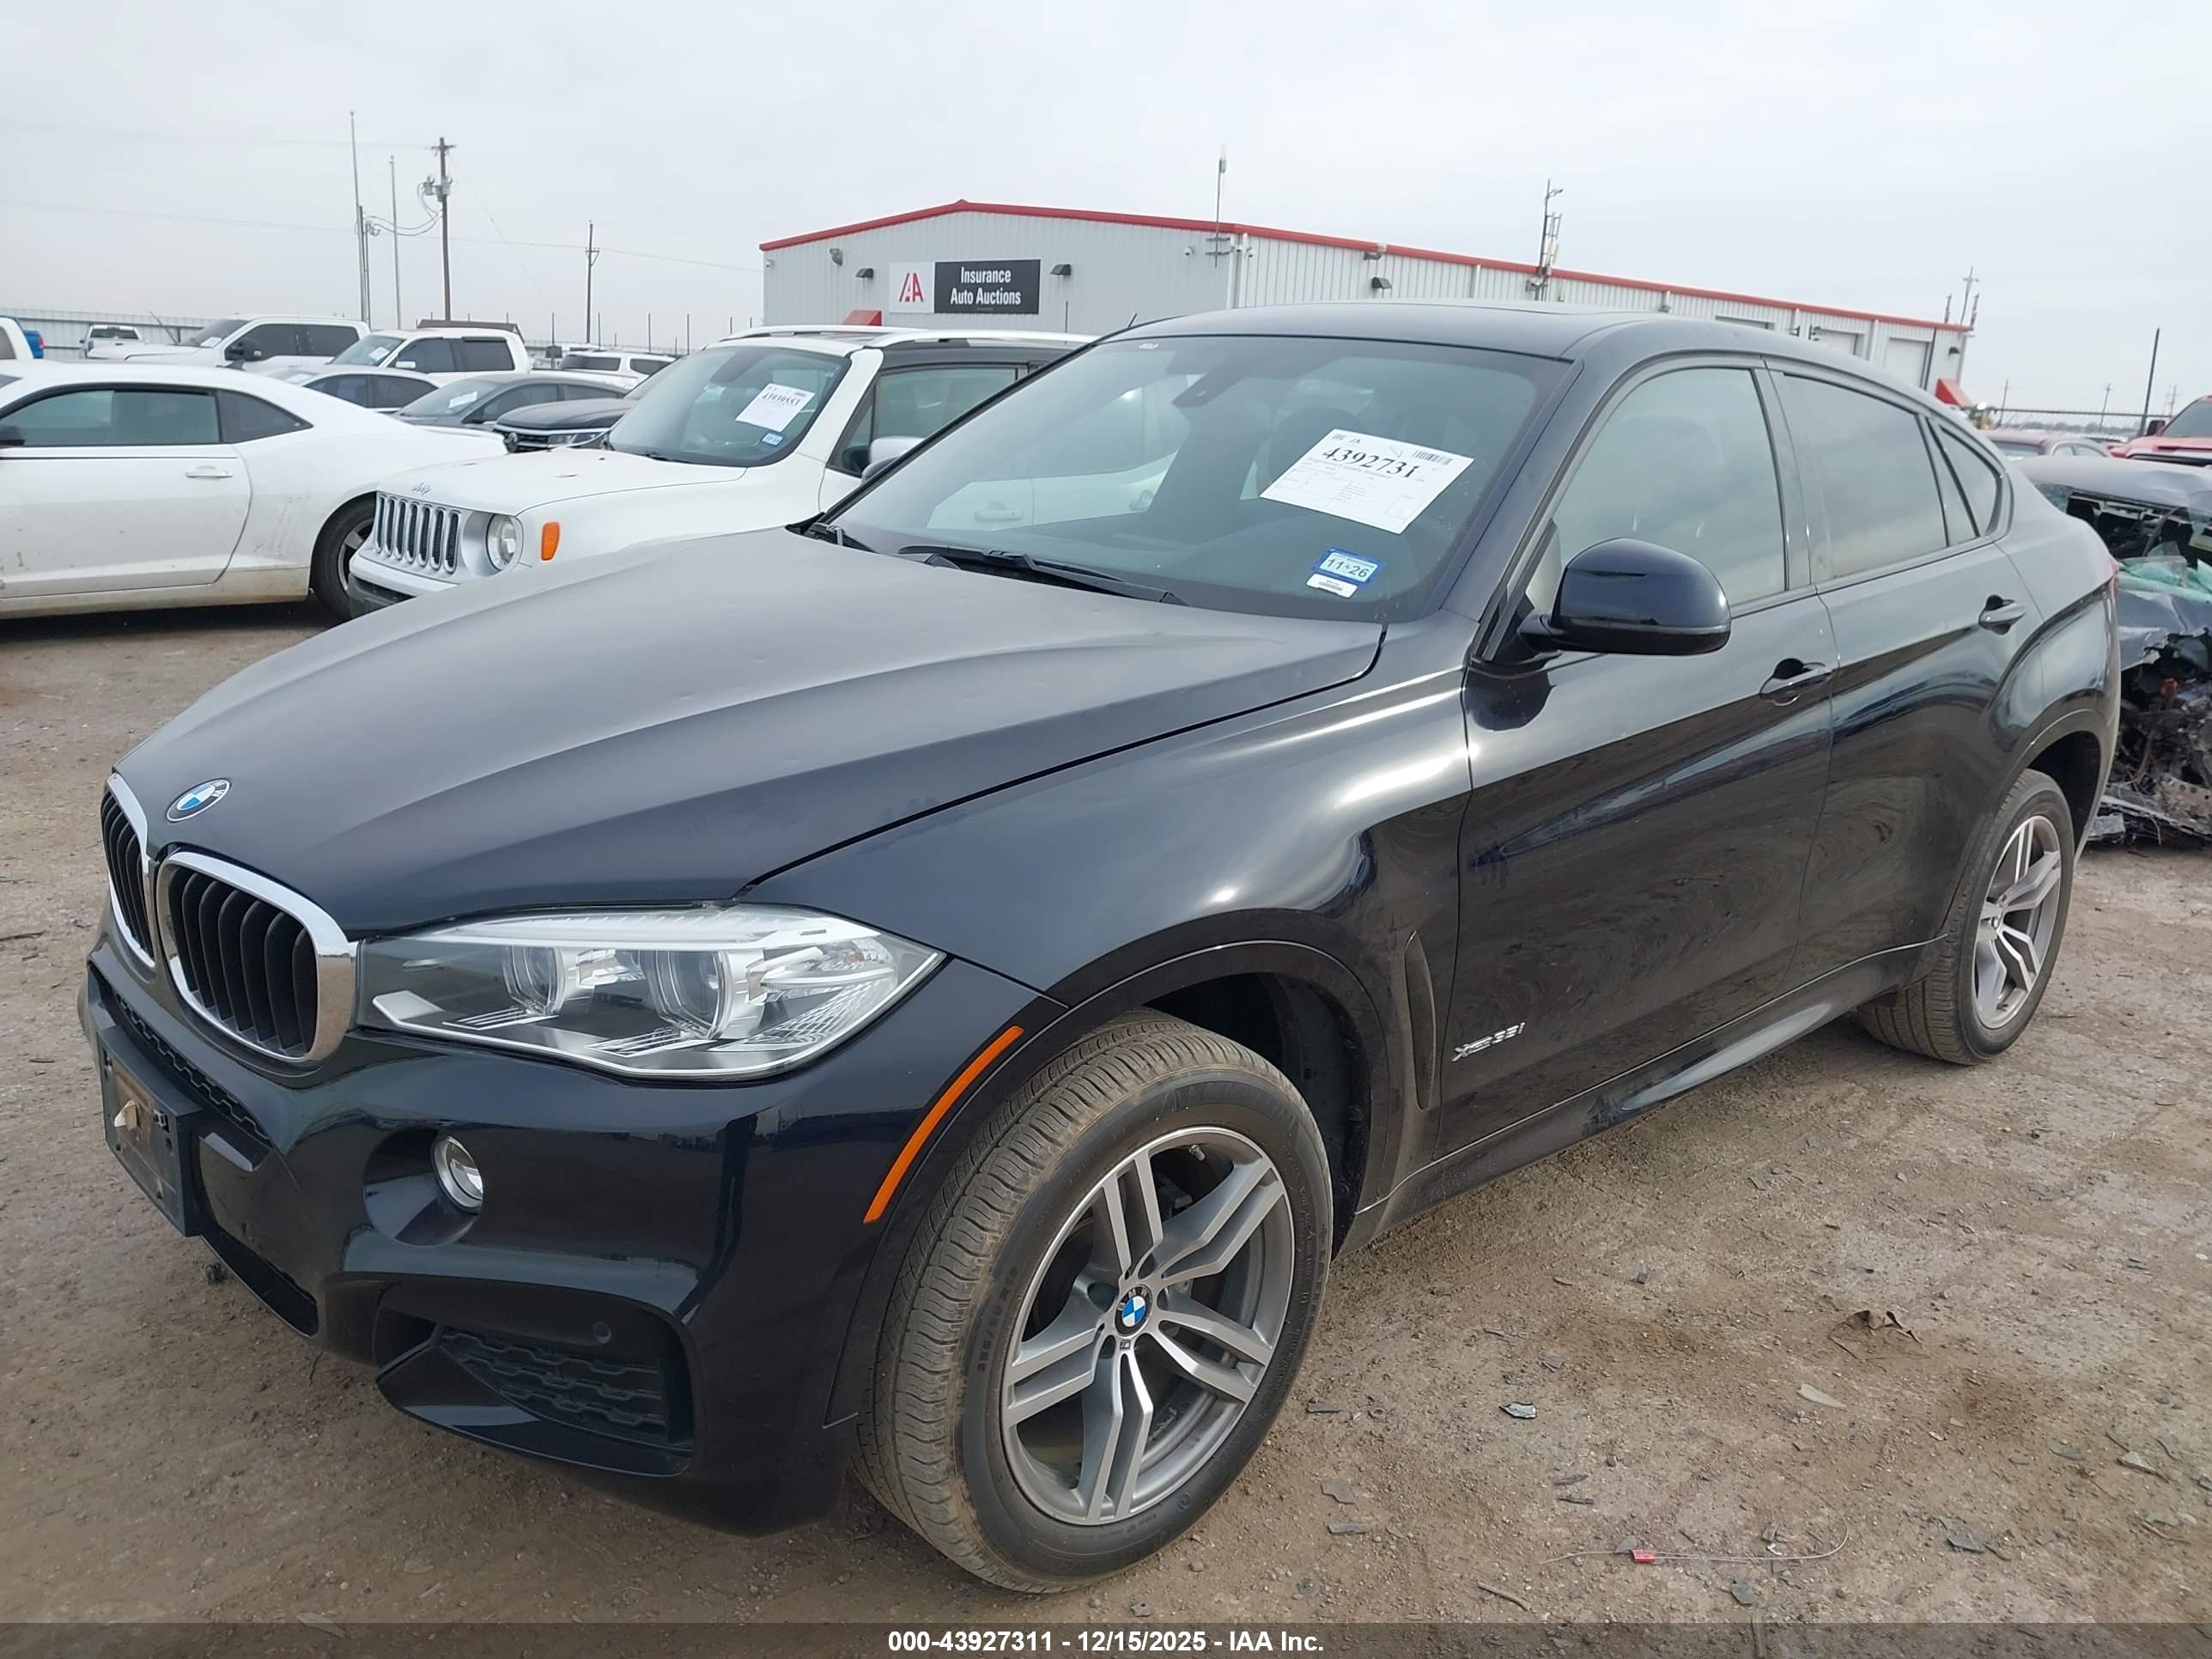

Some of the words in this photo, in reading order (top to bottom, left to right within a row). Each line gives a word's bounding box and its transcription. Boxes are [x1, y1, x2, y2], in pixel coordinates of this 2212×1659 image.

[961, 267, 1012, 283] Insurance
[951, 288, 974, 306] Auto
[975, 288, 1022, 306] Auctions
